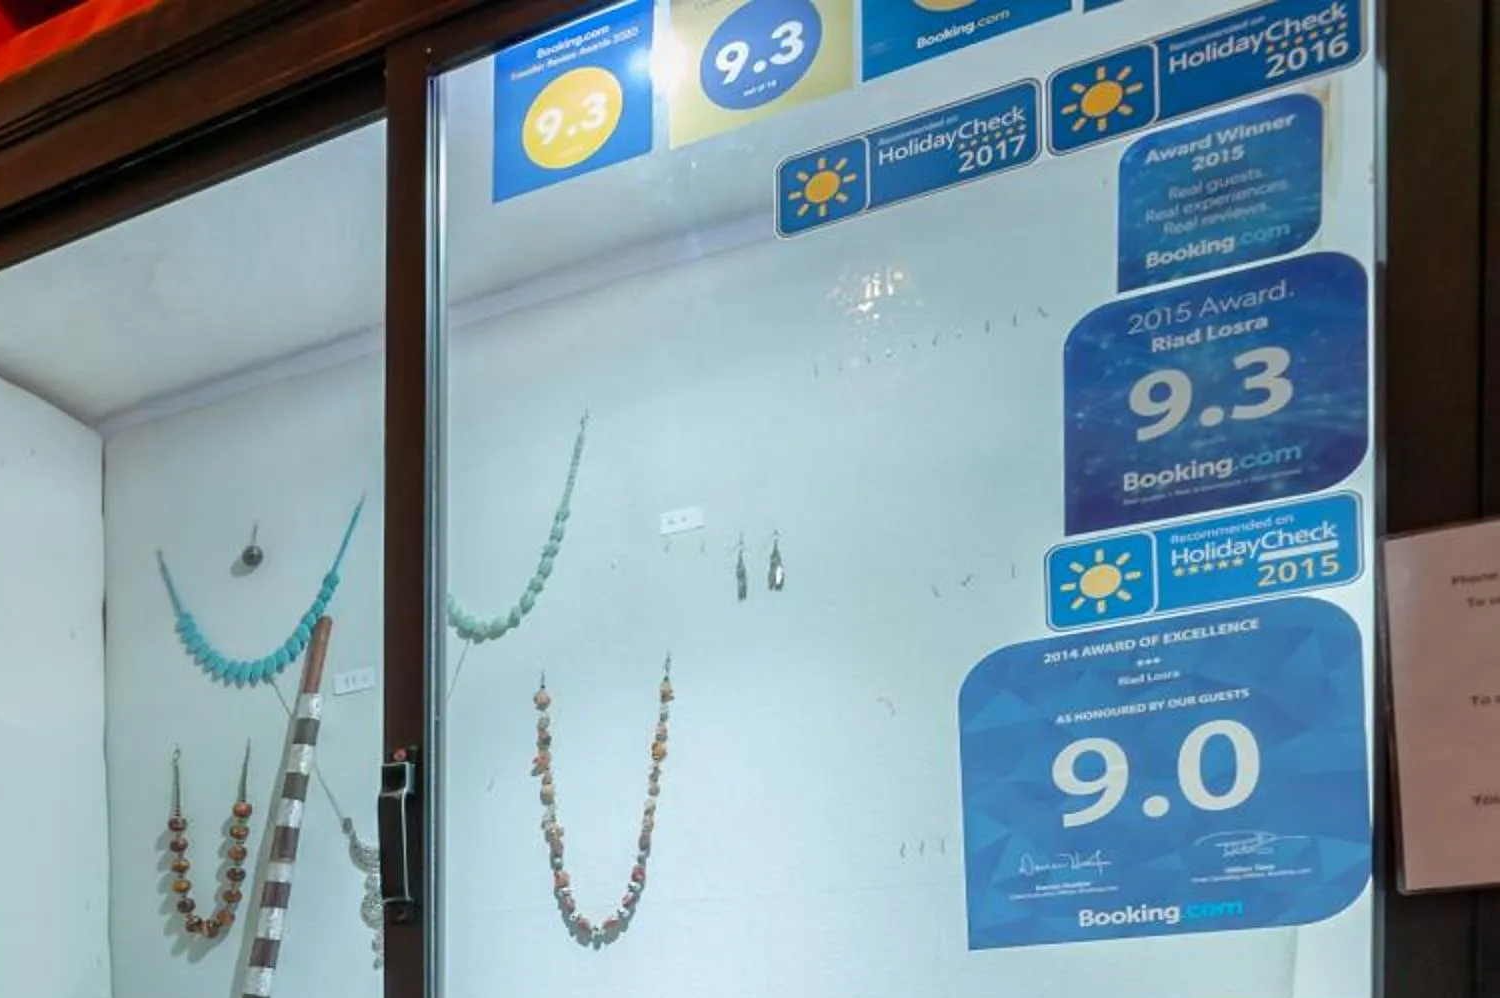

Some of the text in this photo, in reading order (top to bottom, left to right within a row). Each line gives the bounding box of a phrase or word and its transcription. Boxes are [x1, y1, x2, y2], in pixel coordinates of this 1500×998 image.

[916, 10, 1010, 49] Booking.com
[1169, 2, 1347, 74] HolidayCheck
[715, 20, 804, 86] 9.3
[1266, 33, 1348, 79] 2016
[536, 91, 608, 145] 9.3
[878, 105, 1027, 166] HolidayCheck
[1145, 114, 1297, 164] Award Winner
[958, 135, 1027, 173] 2017
[1192, 145, 1245, 171] 2015
[1169, 181, 1202, 200] Real
[1145, 205, 1179, 223] Real
[1164, 216, 1198, 235] Real
[1127, 279, 1295, 335] 2015 Award.
[1152, 316, 1269, 352] Riad Losra
[1129, 346, 1293, 442] 9.3
[1123, 444, 1302, 492] Booking.com
[1170, 514, 1295, 544] Recommended on
[1171, 521, 1338, 566] HolidayCheck
[1258, 554, 1340, 587] 2015
[1043, 618, 1261, 664] 2014 AWARD OF EXCELLENCE
[1055, 688, 1250, 724] AS HONOURED BY OUR GUESTS
[1051, 719, 1261, 828] 9.0
[1079, 898, 1244, 928] Booking.com
